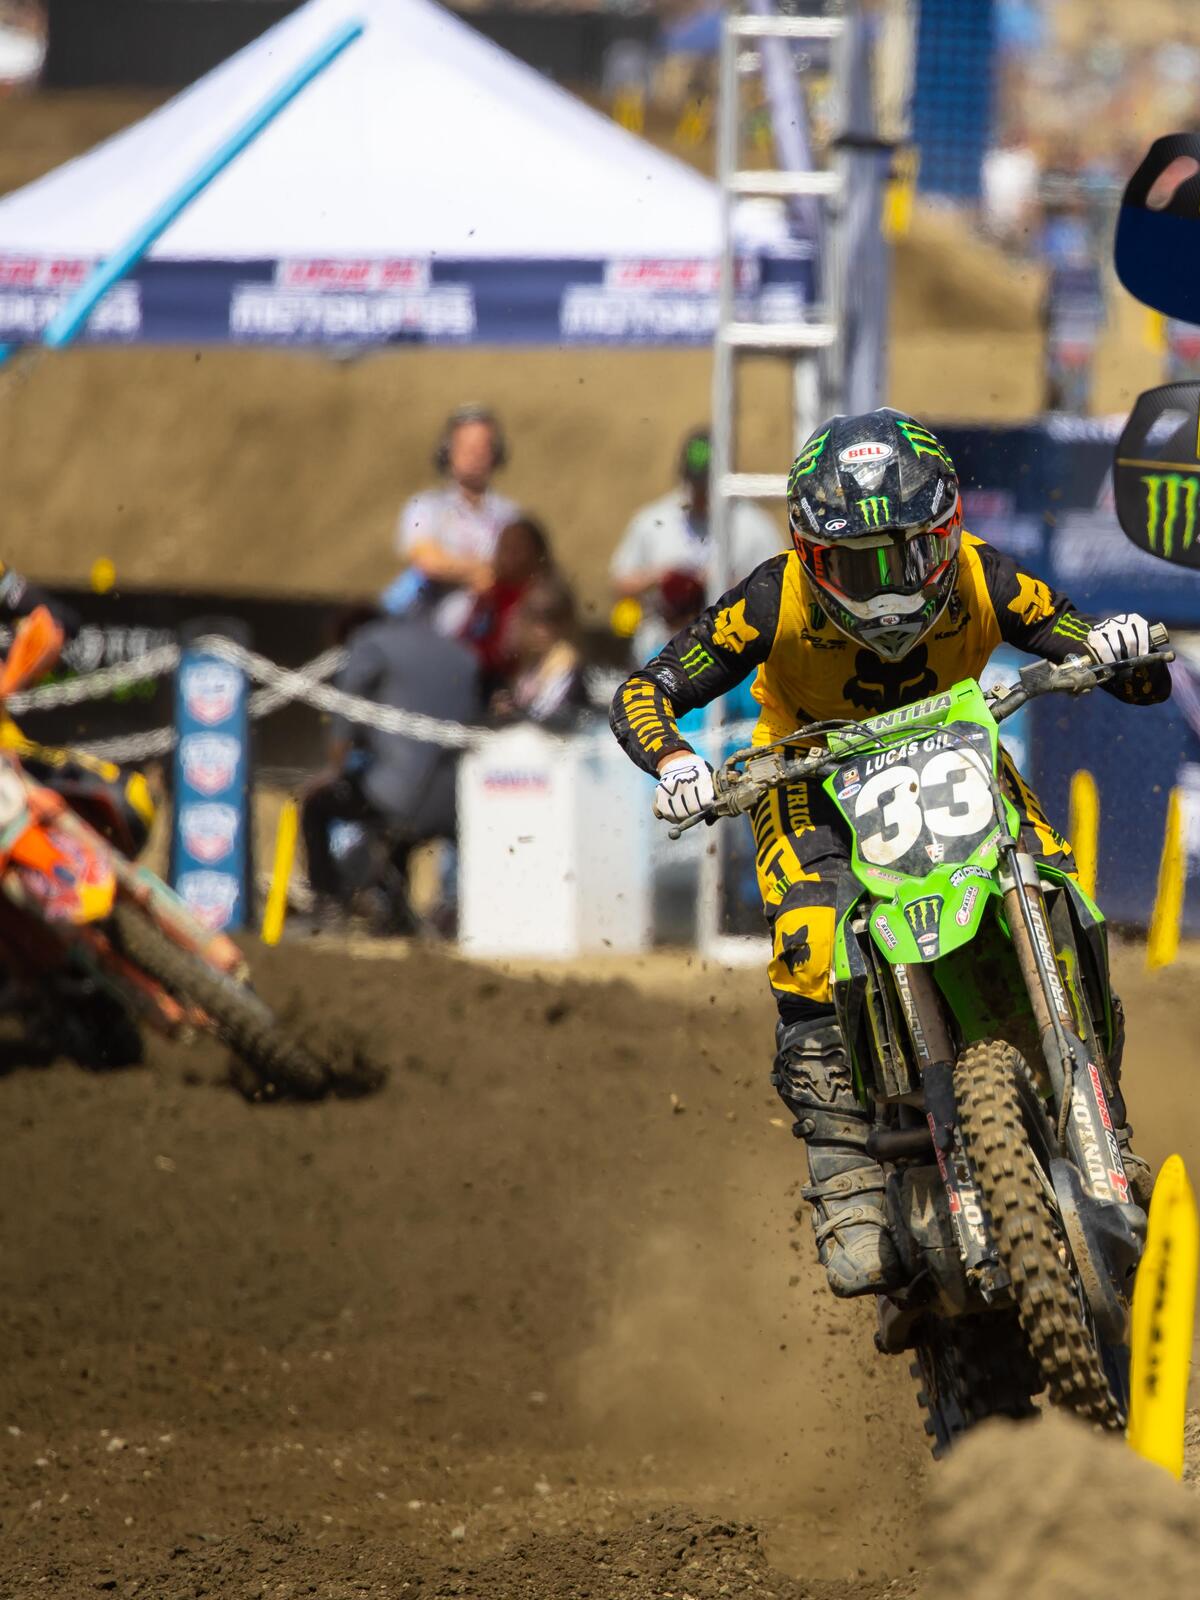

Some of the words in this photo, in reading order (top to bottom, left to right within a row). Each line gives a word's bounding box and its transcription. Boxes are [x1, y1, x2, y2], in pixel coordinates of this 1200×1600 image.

[848, 446, 885, 460] BELL
[865, 741, 919, 777] LUCAS
[922, 732, 954, 753] OIL
[854, 747, 996, 867] 33
[1026, 895, 1056, 976] CIRCUIT
[1044, 968, 1070, 1015] PRO
[1071, 1085, 1114, 1203] DUNLOP
